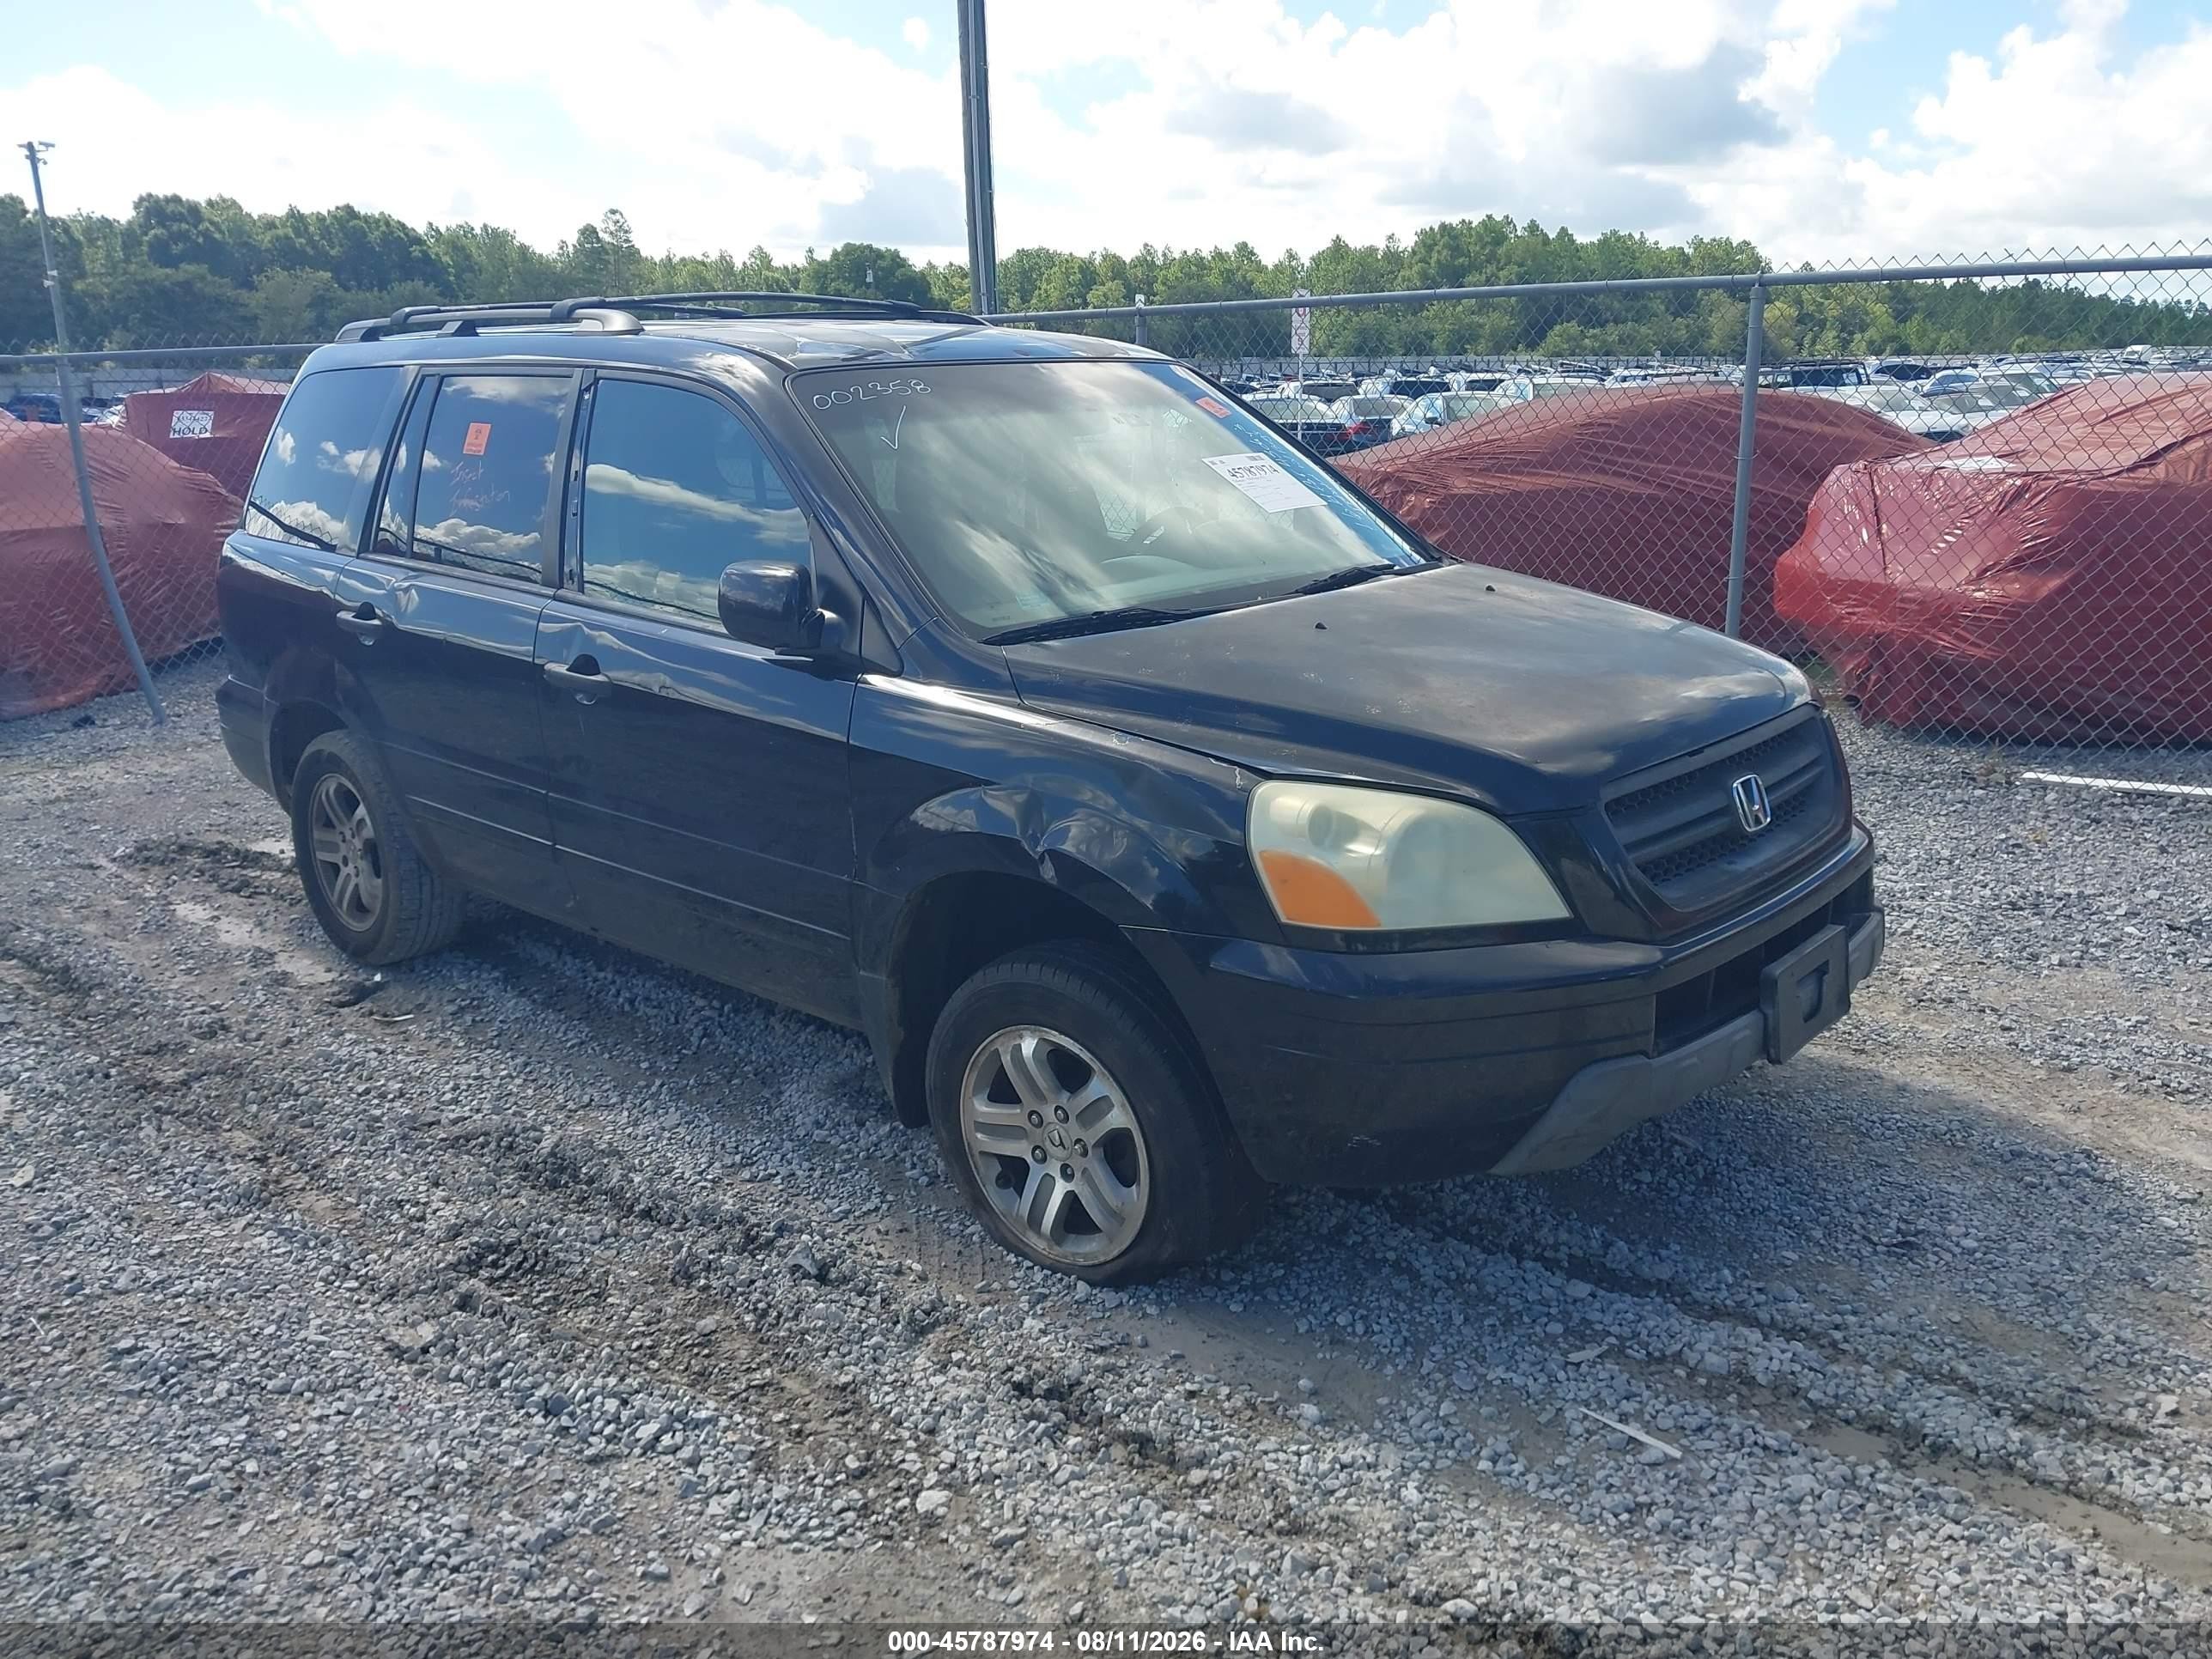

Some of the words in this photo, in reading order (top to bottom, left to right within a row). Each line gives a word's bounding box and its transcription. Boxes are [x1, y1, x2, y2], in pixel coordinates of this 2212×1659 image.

[813, 379, 932, 410] 002358
[172, 427, 209, 436] HOLD
[1226, 464, 1280, 479] 45787974
